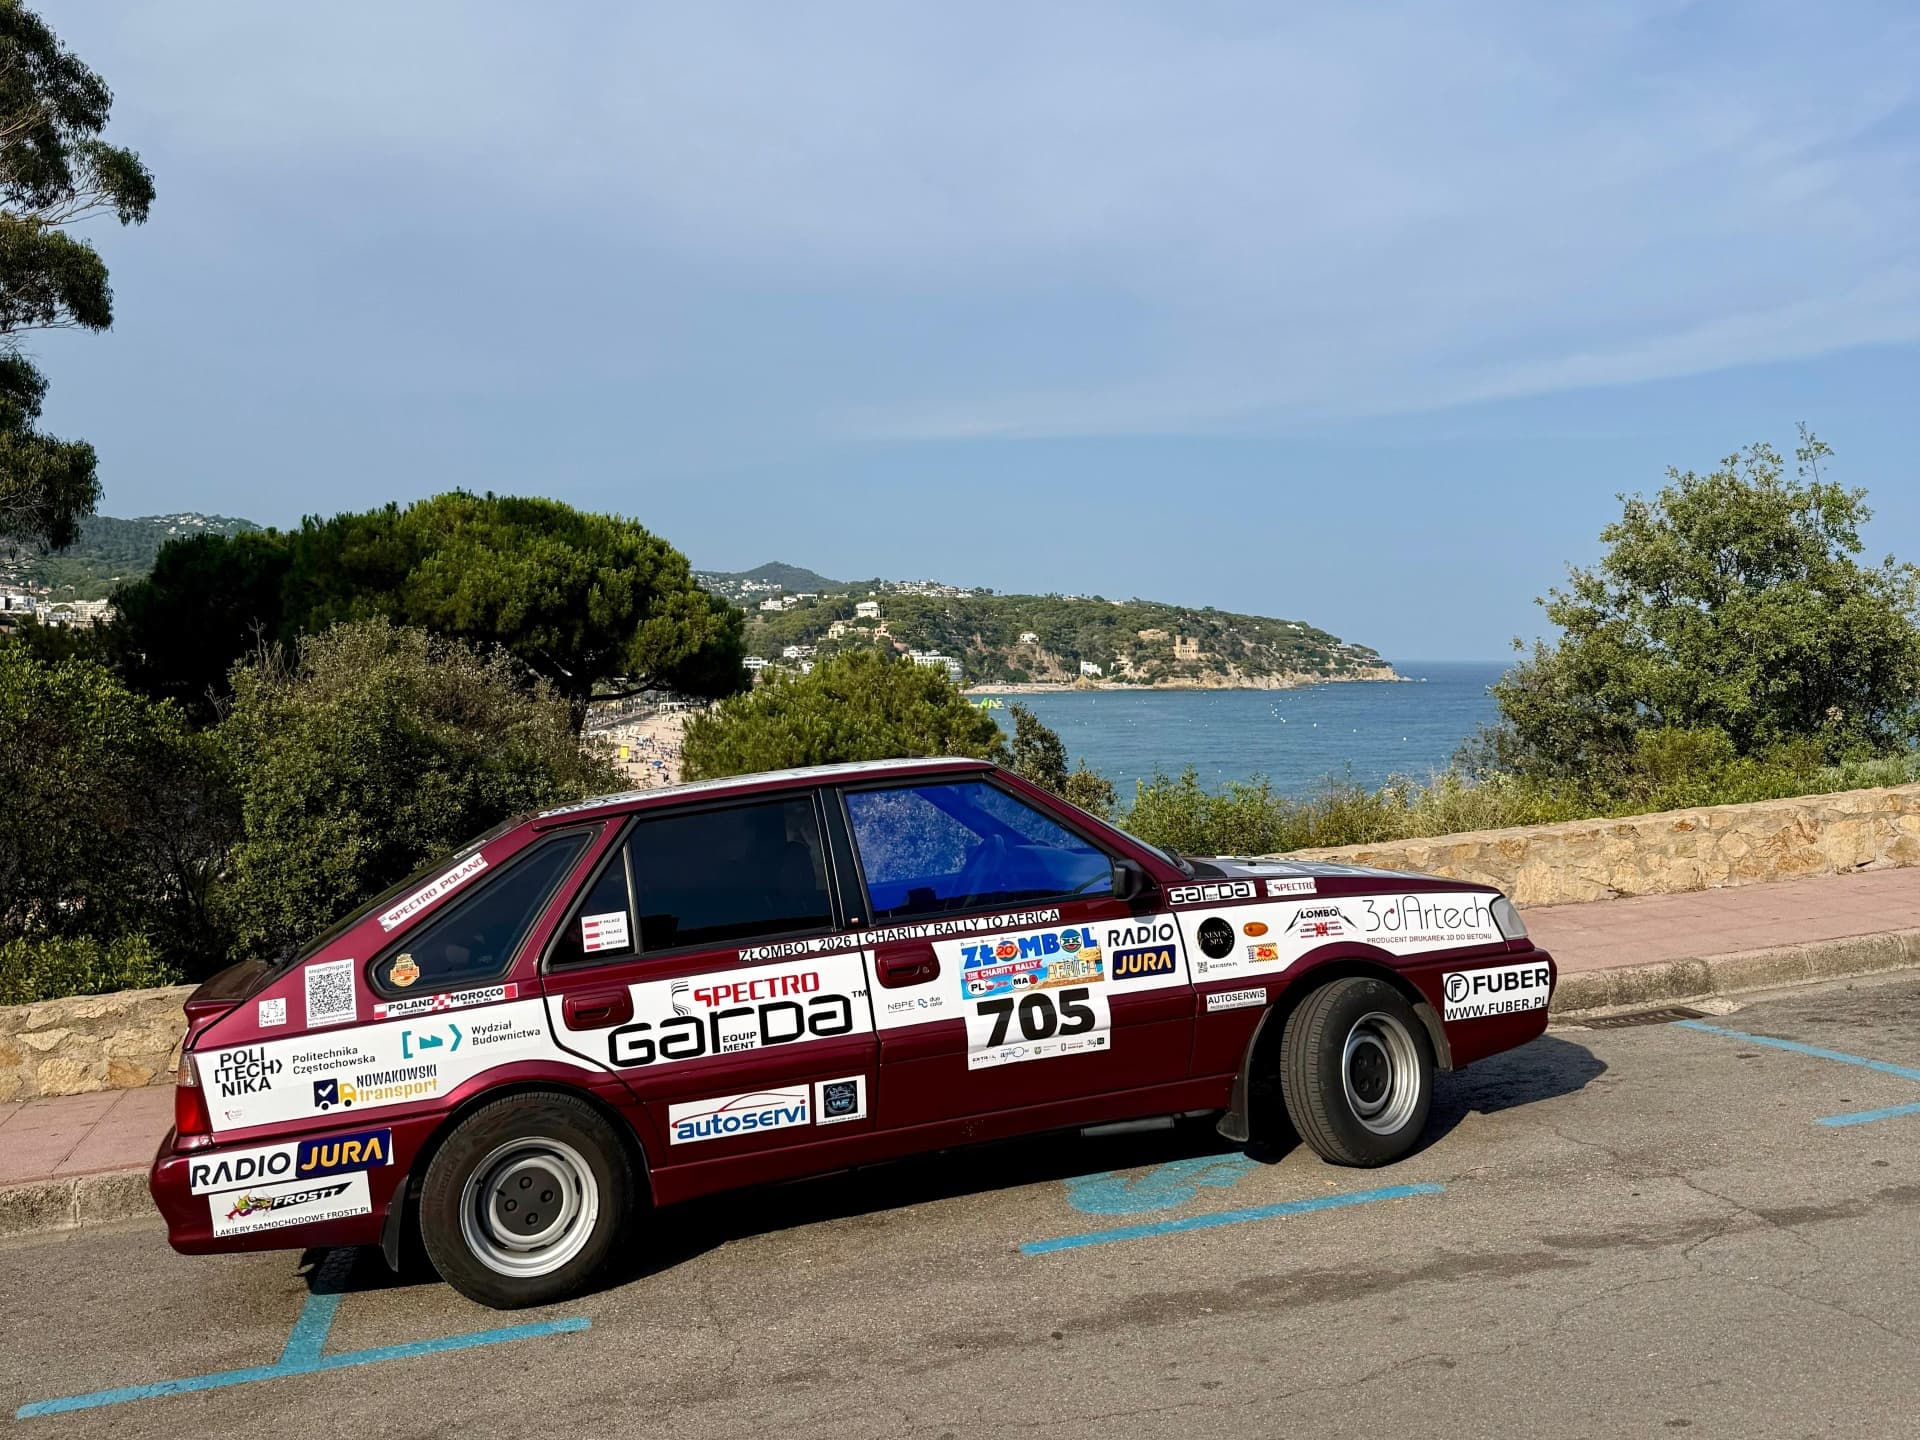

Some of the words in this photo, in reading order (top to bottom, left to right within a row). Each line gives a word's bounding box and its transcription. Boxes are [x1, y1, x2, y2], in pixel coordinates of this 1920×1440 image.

[388, 888, 437, 922] SPECTRO
[439, 855, 487, 890] POLAND
[1273, 881, 1316, 892] SPECTRO
[865, 925, 929, 945] CHARITY
[934, 918, 979, 936] RALLY
[985, 915, 1004, 928] TO
[1007, 909, 1060, 925] AFRICA
[1108, 923, 1174, 947] RADIO
[740, 941, 815, 962] ZŁOMBOL
[818, 934, 852, 949] 2026
[1366, 935, 1408, 944] PRODUCENT
[1409, 934, 1446, 942] DRUKAREK
[1466, 932, 1492, 941] BETONU
[966, 972, 979, 981] THE
[980, 965, 1014, 979] CHARITY
[1014, 960, 1038, 973] RALLY
[1116, 952, 1172, 975] JURA
[693, 971, 820, 1008] SPECTRO
[970, 983, 985, 992] PL
[1013, 977, 1029, 986] MA
[1472, 968, 1549, 995] FUBER
[388, 998, 435, 1013] POLAND
[450, 987, 504, 1003] MOROCCO
[1207, 989, 1265, 1005] AUTOSERWIS
[976, 986, 1097, 1049] 705
[1445, 994, 1549, 1022] WWW.FUBER.PL
[471, 1021, 513, 1036] Wydział
[472, 1027, 541, 1047] Budownictwa
[722, 1031, 757, 1043] EQUIP
[220, 1046, 265, 1068] POLI
[292, 1046, 359, 1064] Politechnika
[723, 1041, 756, 1053] MENT
[293, 1054, 376, 1075] Częstochowska
[356, 1064, 438, 1088] NOWAKOWSKI
[221, 1077, 272, 1098] NIKA
[360, 1078, 438, 1103] transport
[676, 1098, 807, 1141] autoservi
[301, 1137, 384, 1171] JURA
[191, 1151, 291, 1188] RADIO
[273, 1187, 340, 1207] FROSTT
[215, 1224, 251, 1237] LAKIERY
[252, 1212, 326, 1231] SAMOCHODOWE
[326, 1206, 370, 1220] FROSTT.PL
